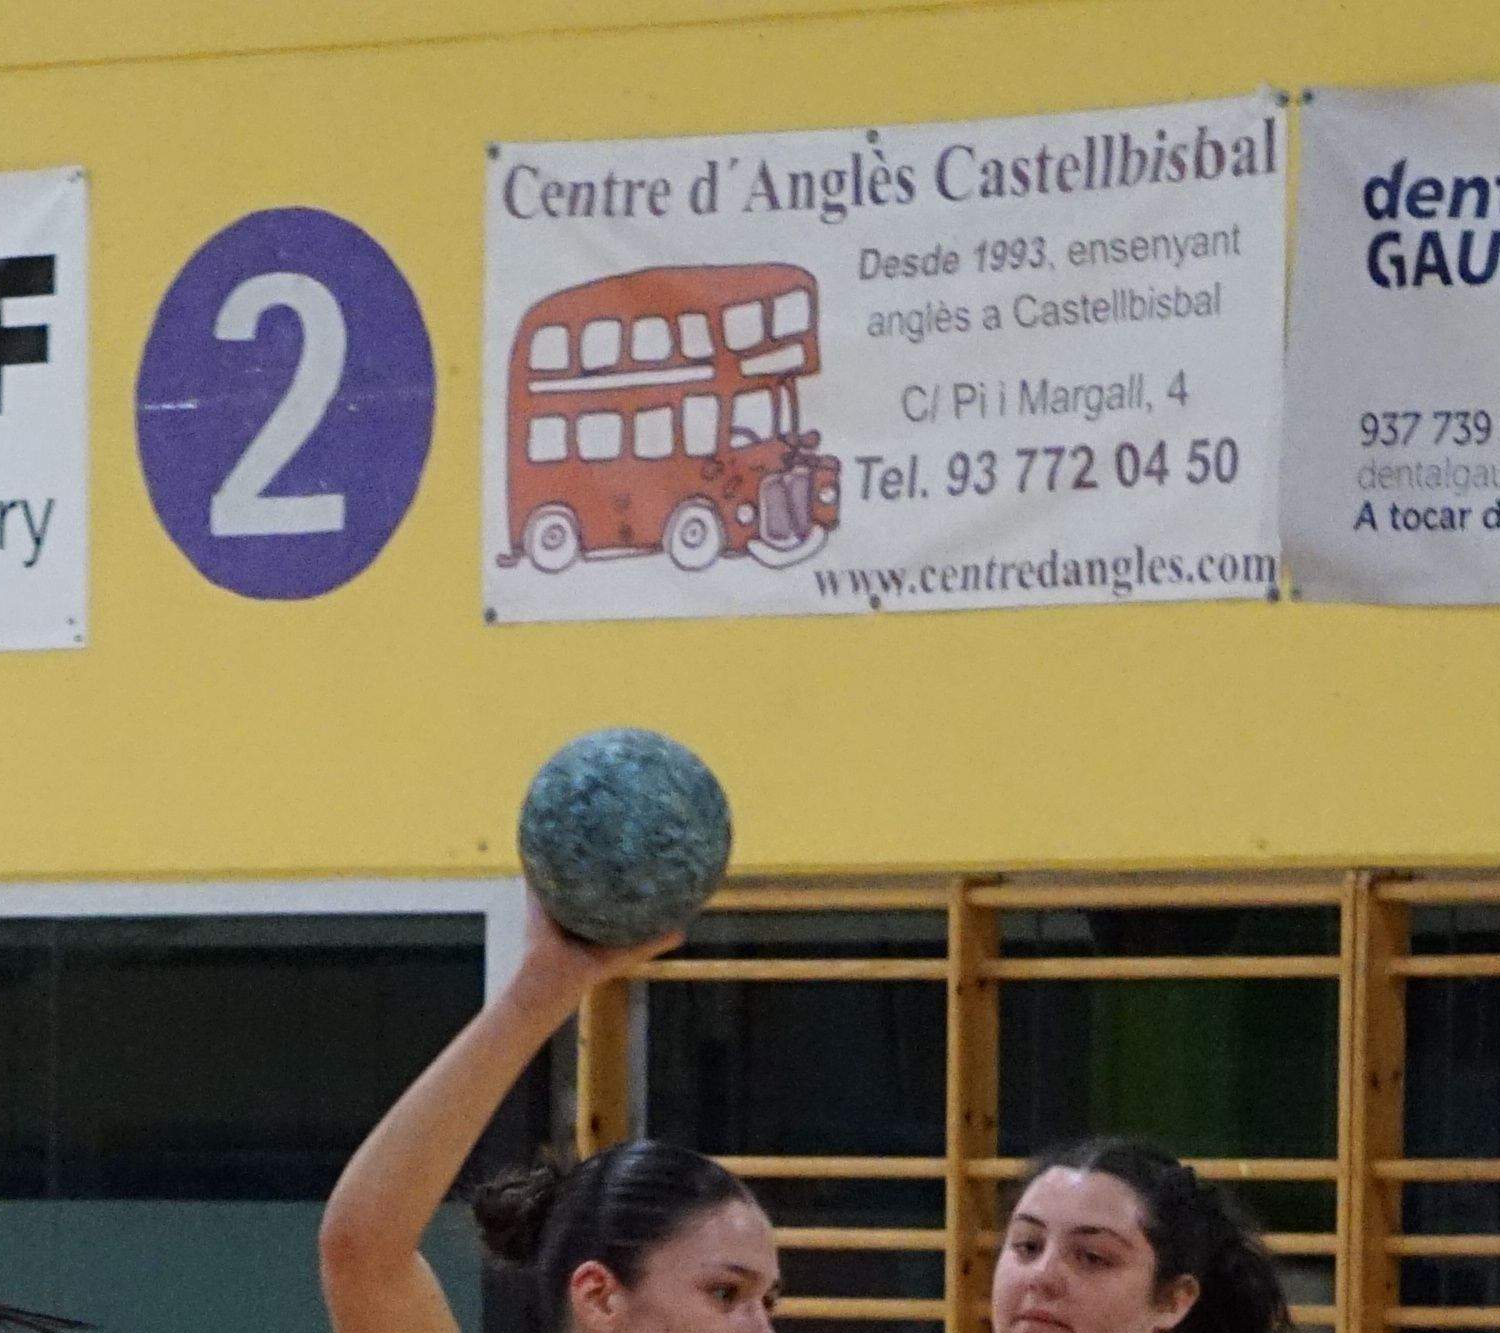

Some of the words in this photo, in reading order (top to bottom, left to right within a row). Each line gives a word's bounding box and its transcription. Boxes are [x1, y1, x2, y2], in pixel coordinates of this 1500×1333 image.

[503, 161, 672, 219] Centre
[935, 119, 1276, 201] Castellbisbal
[859, 244, 959, 280] Desde
[972, 236, 1056, 273] 1993,
[1067, 225, 1242, 267] ensenyant
[868, 300, 970, 340] anglès
[982, 304, 1001, 330] a
[1014, 284, 1222, 328] Castellbisbal
[210, 271, 347, 536] 2
[901, 382, 939, 423] C/
[953, 380, 986, 418] Pi
[999, 381, 1007, 415] i
[1018, 374, 1153, 422] Margall,
[1167, 371, 1188, 405] 4
[1359, 410, 1422, 446] 937
[1431, 409, 1494, 444] 739
[856, 454, 930, 499] Tel.
[946, 451, 997, 495] 93
[1015, 447, 1097, 493] 772
[1115, 444, 1167, 486] 04
[1187, 439, 1239, 484] 50
[1353, 497, 1378, 532] A
[1389, 499, 1473, 532] tocar
[814, 544, 1276, 599] www.centredangles.com
